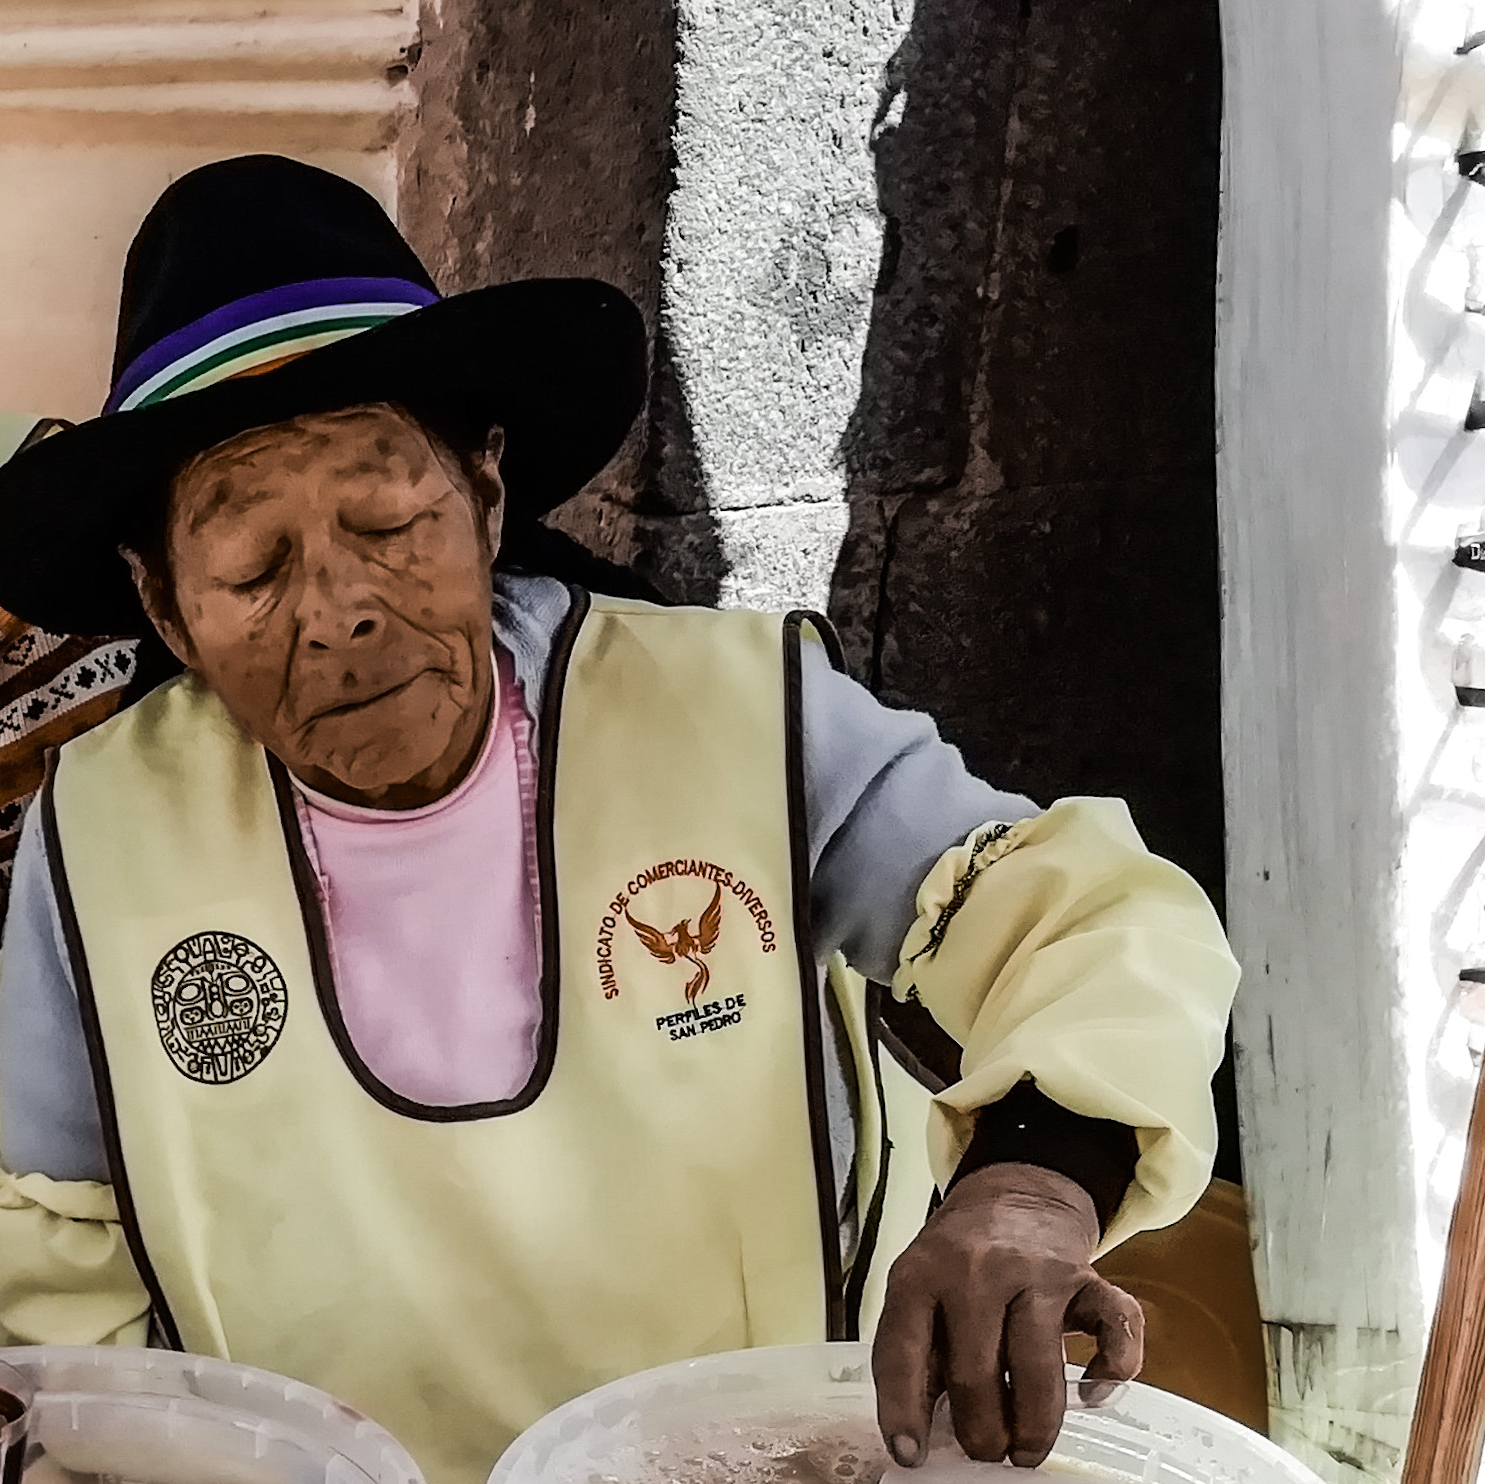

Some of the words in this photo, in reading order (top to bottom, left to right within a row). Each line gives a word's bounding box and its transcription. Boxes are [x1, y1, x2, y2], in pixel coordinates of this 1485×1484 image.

[596, 916, 620, 1000] SINDICATO
[609, 892, 630, 915] DE
[627, 859, 734, 895] COMERCIANTES
[732, 880, 776, 953] DIVERSOS
[655, 1001, 722, 1030] PERFILES
[725, 994, 747, 1010] DE
[669, 1023, 697, 1041] SAN
[701, 1011, 741, 1034] PEDRO
